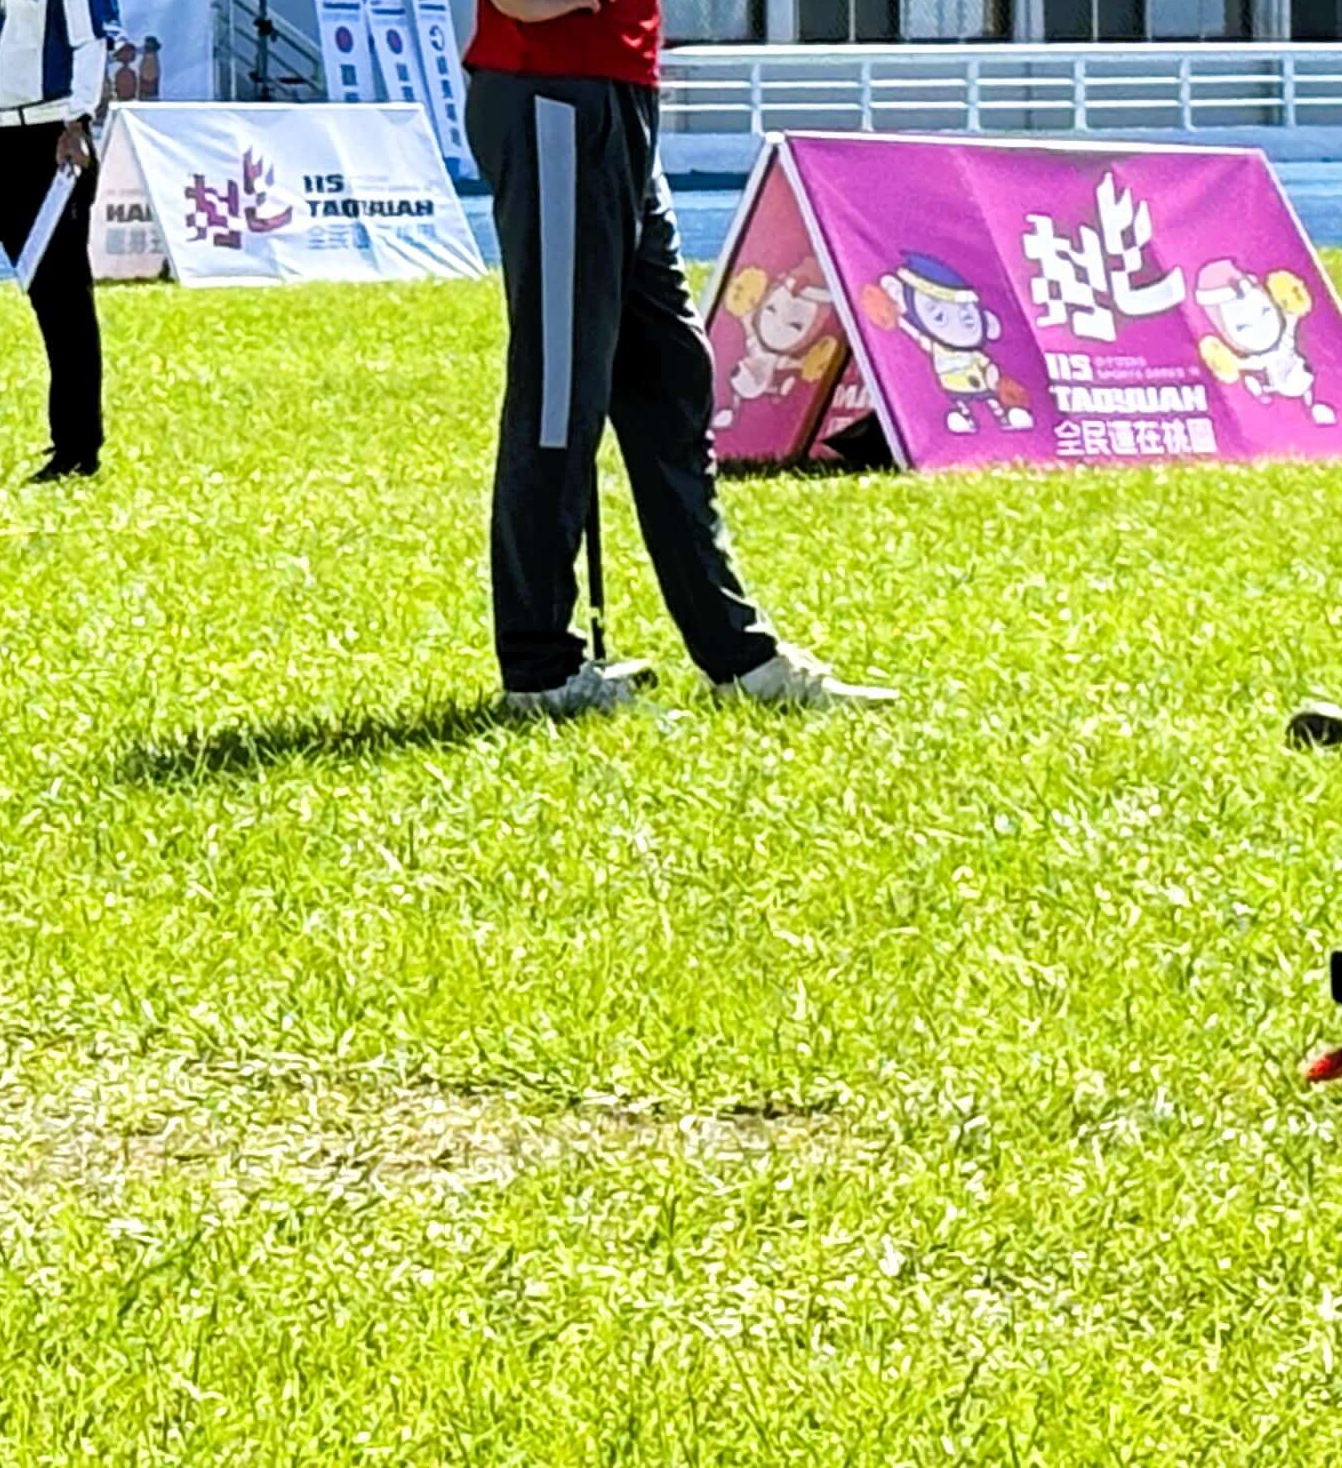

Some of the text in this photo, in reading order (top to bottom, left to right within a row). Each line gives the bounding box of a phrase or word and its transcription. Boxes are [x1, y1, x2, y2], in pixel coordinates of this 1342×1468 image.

[1045, 352, 1094, 381] 115
[1049, 385, 1209, 413] TAOYUAN
[1054, 417, 1219, 456] 全民運在桃園
